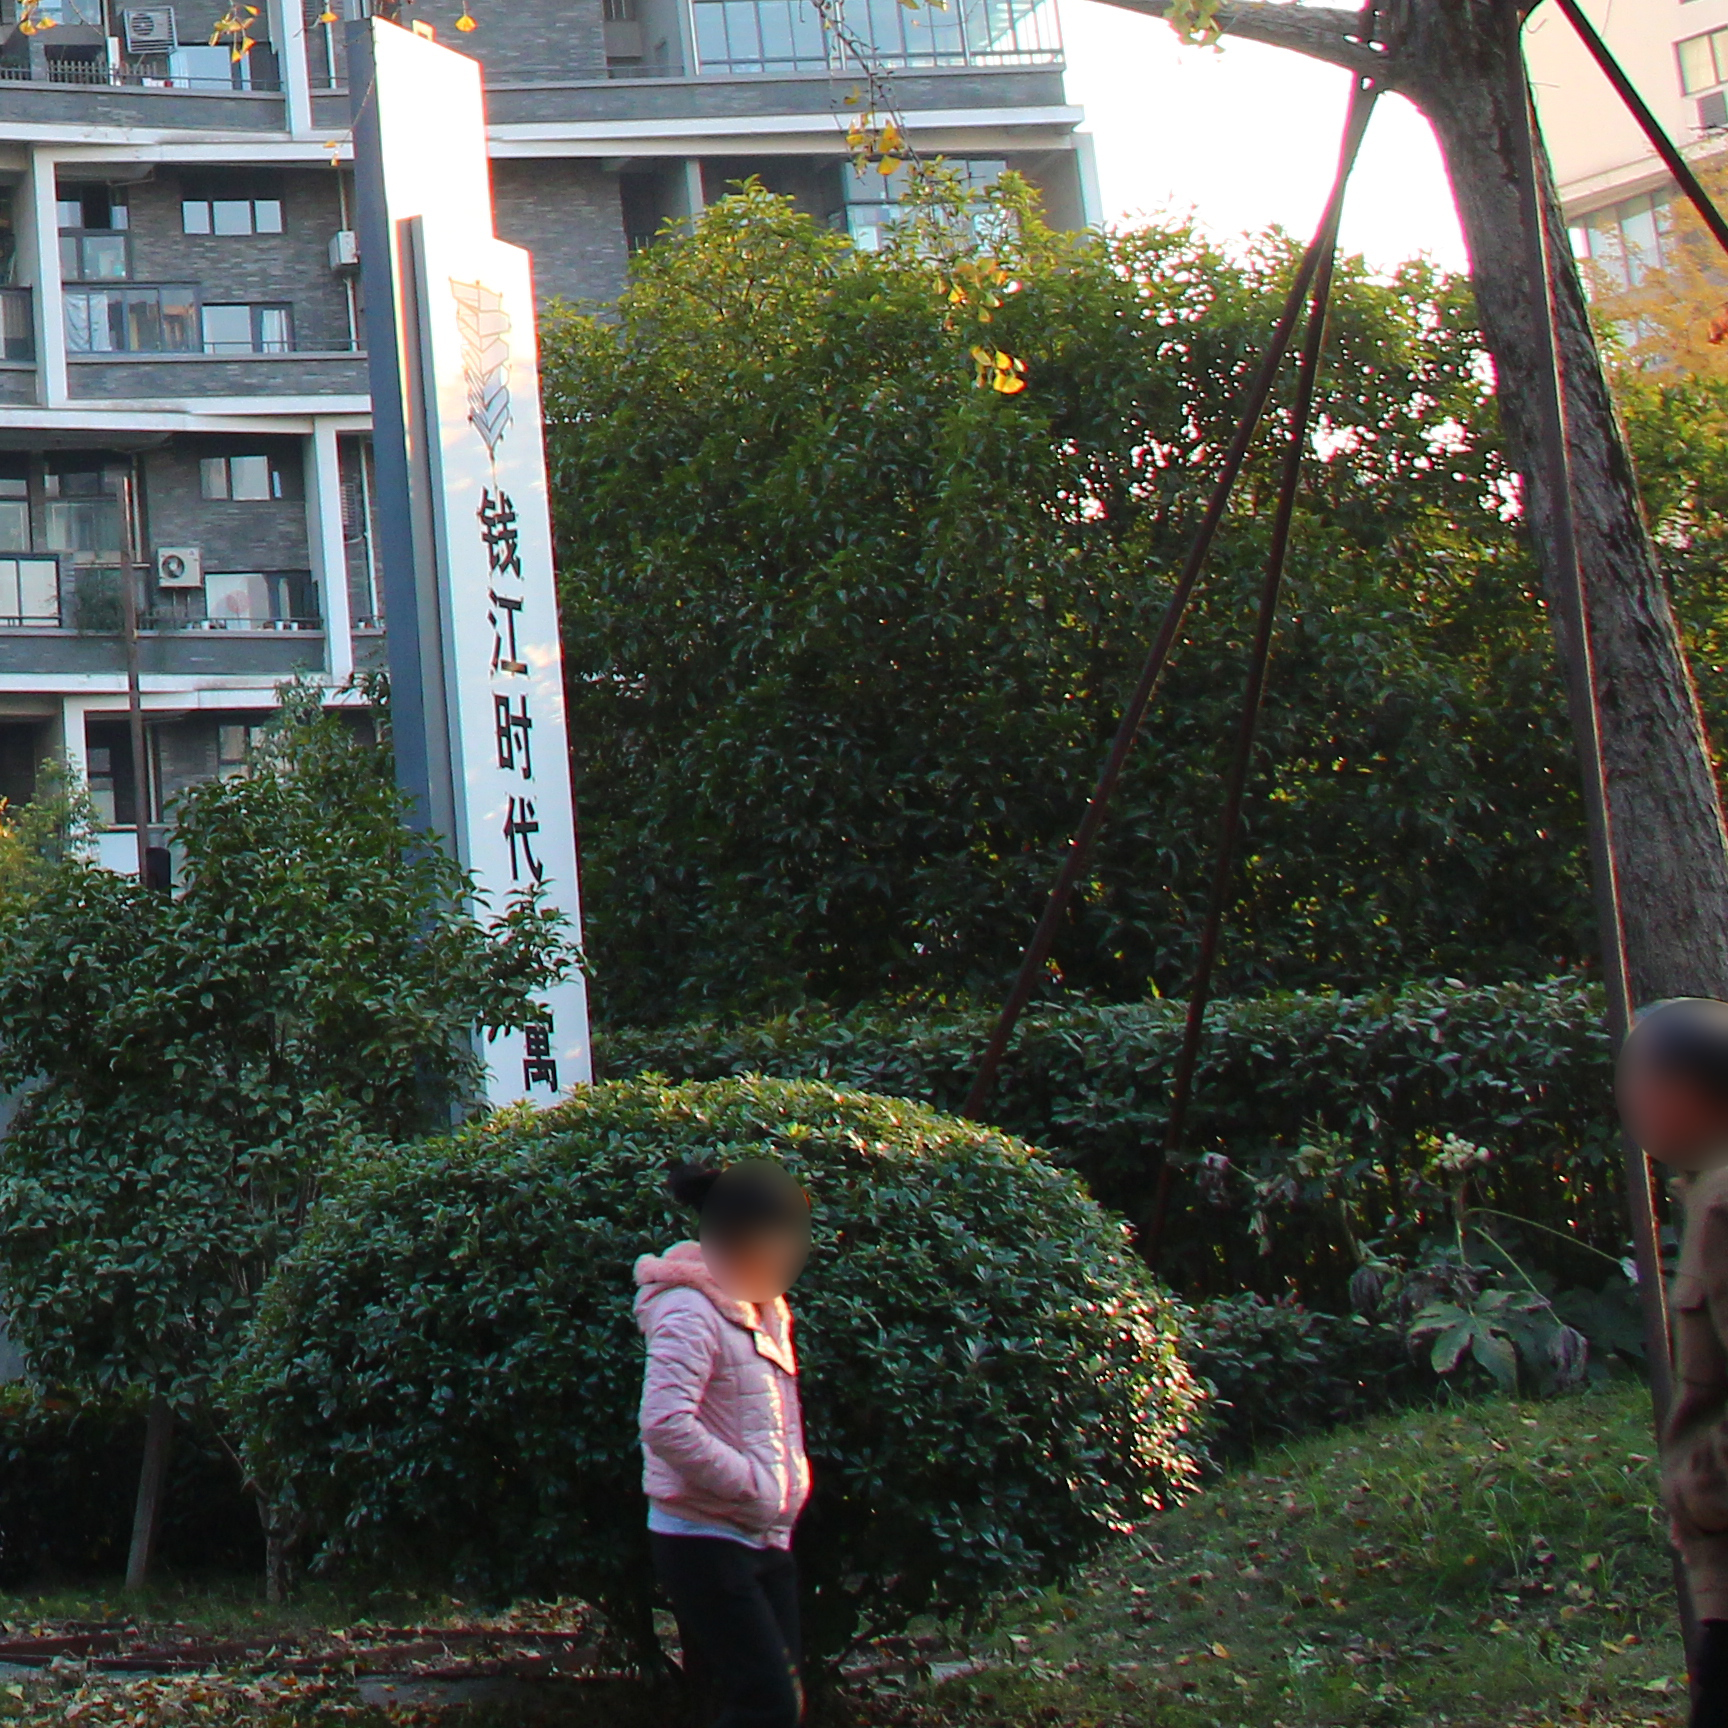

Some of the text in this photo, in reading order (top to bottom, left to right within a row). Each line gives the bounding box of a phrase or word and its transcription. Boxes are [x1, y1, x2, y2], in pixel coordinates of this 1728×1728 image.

[478, 485, 559, 1093] 钱江时代寓
